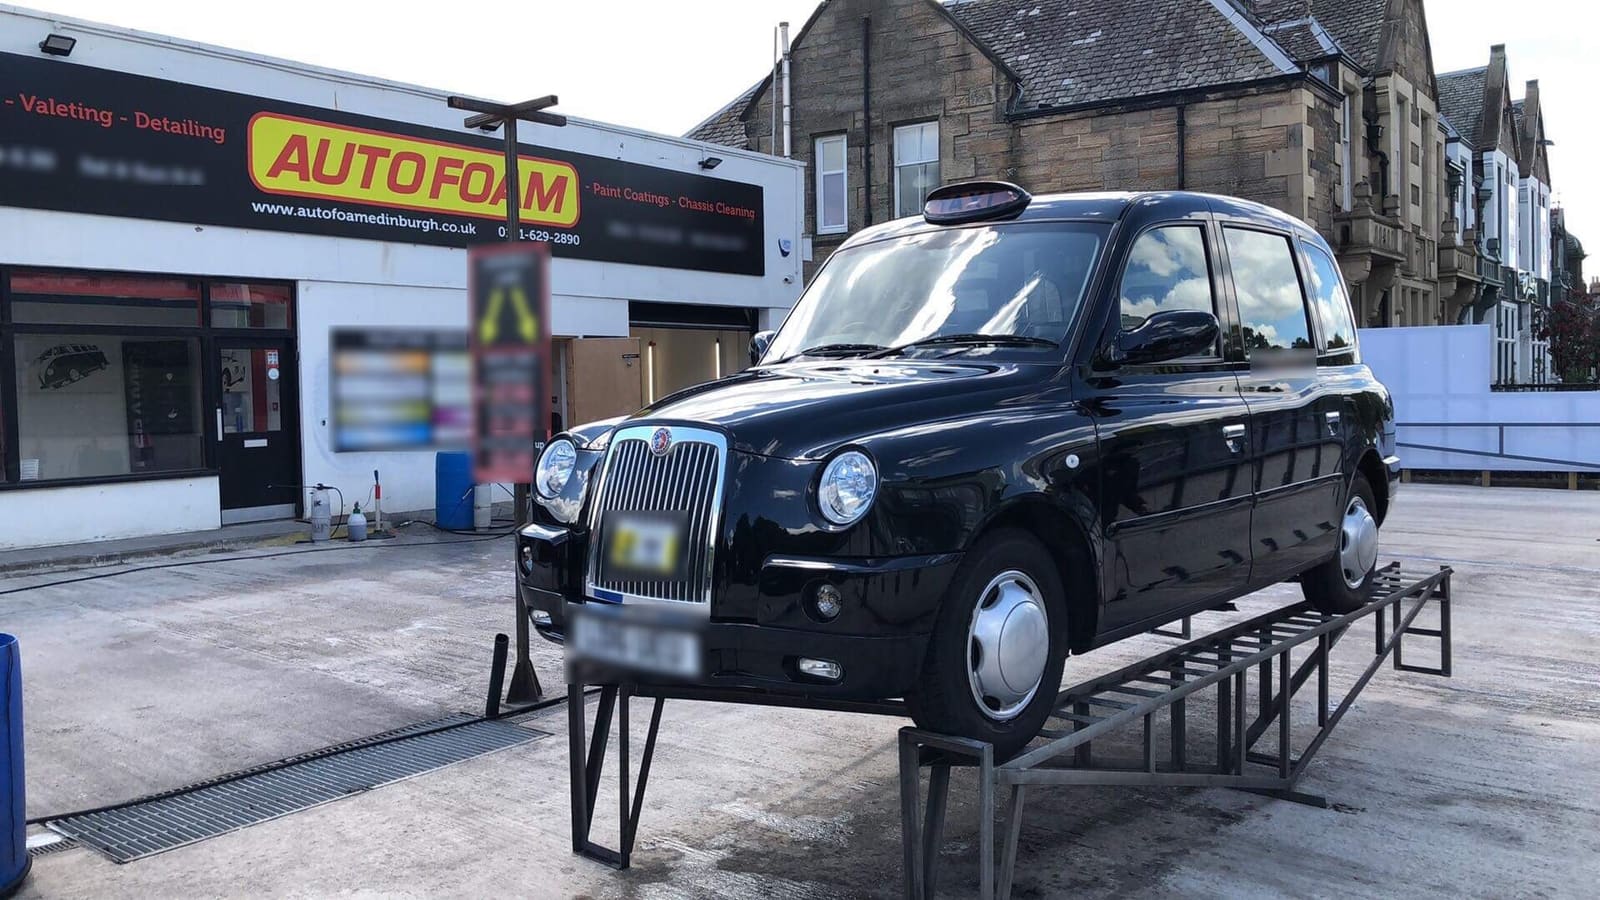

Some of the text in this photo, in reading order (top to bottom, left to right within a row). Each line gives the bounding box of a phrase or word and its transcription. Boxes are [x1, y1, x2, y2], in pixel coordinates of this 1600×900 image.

[19, 93, 113, 128] Valeting
[134, 111, 226, 144] Detailing
[593, 182, 621, 198] Paint
[623, 187, 670, 207] Coatings
[678, 196, 714, 212] Chassis
[715, 202, 756, 219] Cleaning
[251, 202, 477, 234] www.autofoamedinburgh.co.uk
[498, 226, 580, 246] 01-629-2890
